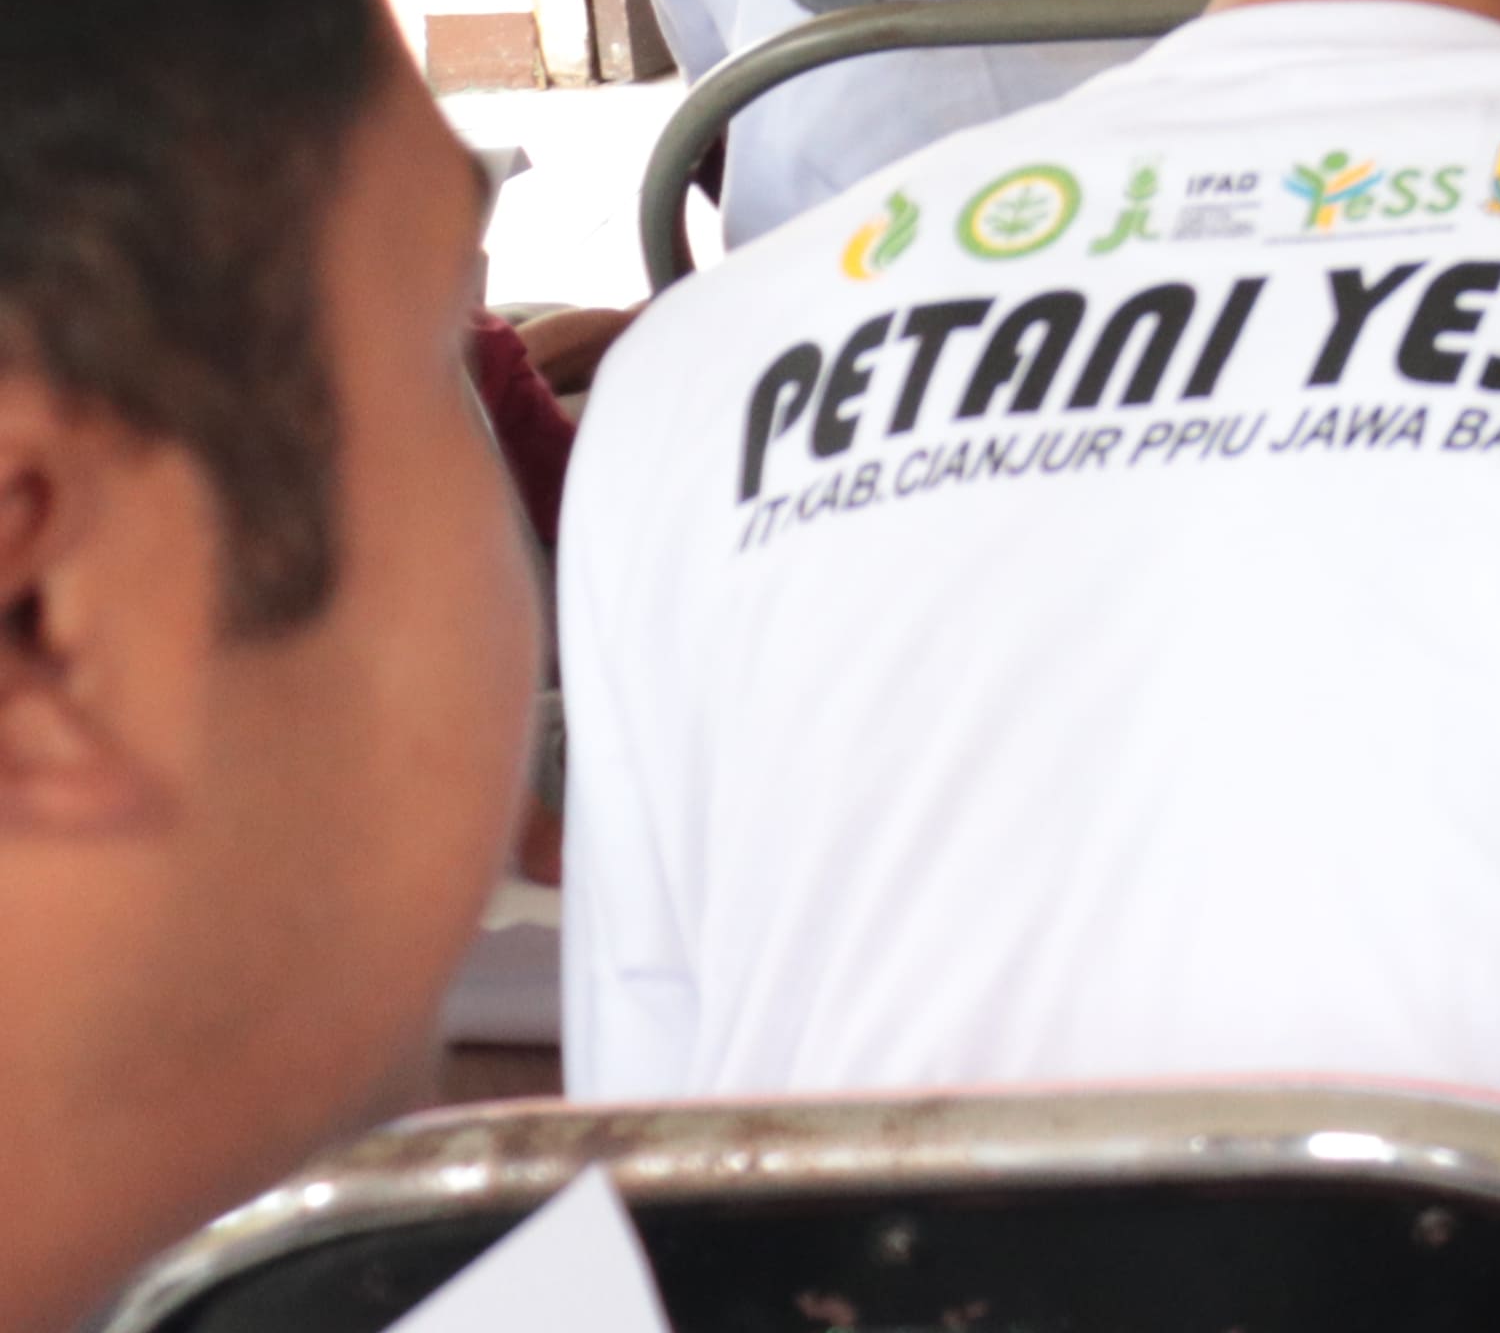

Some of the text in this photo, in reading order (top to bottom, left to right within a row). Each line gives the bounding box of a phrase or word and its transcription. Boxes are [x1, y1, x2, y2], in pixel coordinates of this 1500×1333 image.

[736, 276, 1273, 507] PETANI
[1128, 419, 1264, 467] PPIU
[1268, 403, 1426, 457] JAWA
